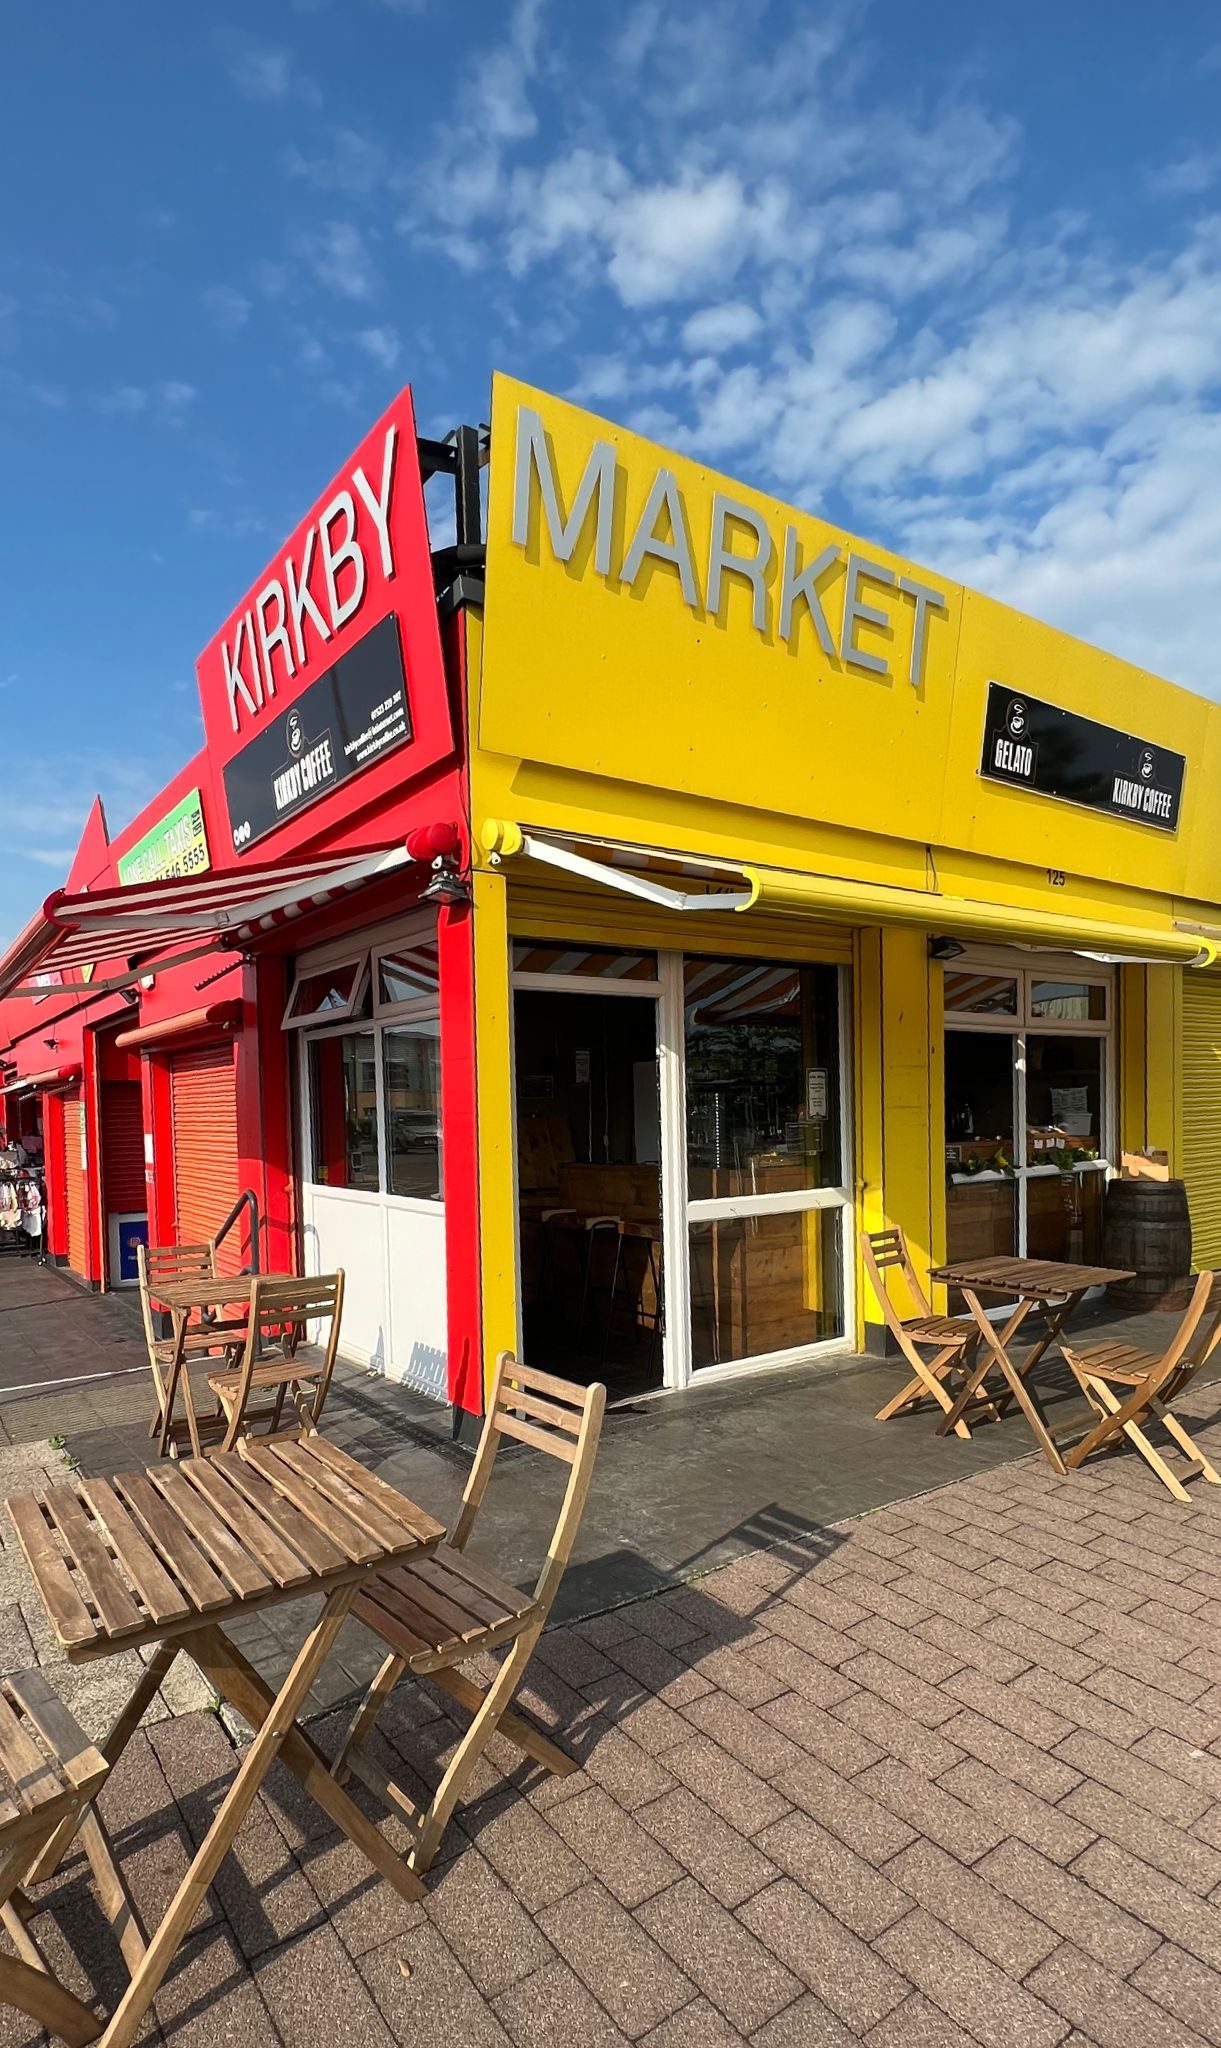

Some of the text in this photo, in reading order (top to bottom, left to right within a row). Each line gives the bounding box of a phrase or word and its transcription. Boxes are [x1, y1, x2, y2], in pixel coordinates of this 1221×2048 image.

[512, 404, 946, 686] MARKET
[221, 424, 396, 732] KIRKBY
[273, 739, 333, 810] KIRKBY COFFEE
[994, 738, 1033, 776] GELATO
[1112, 777, 1172, 818] KIRKBY COFFEE
[163, 814, 192, 861] TAXIS
[182, 843, 205, 873] 5555
[1046, 869, 1066, 886] 125
